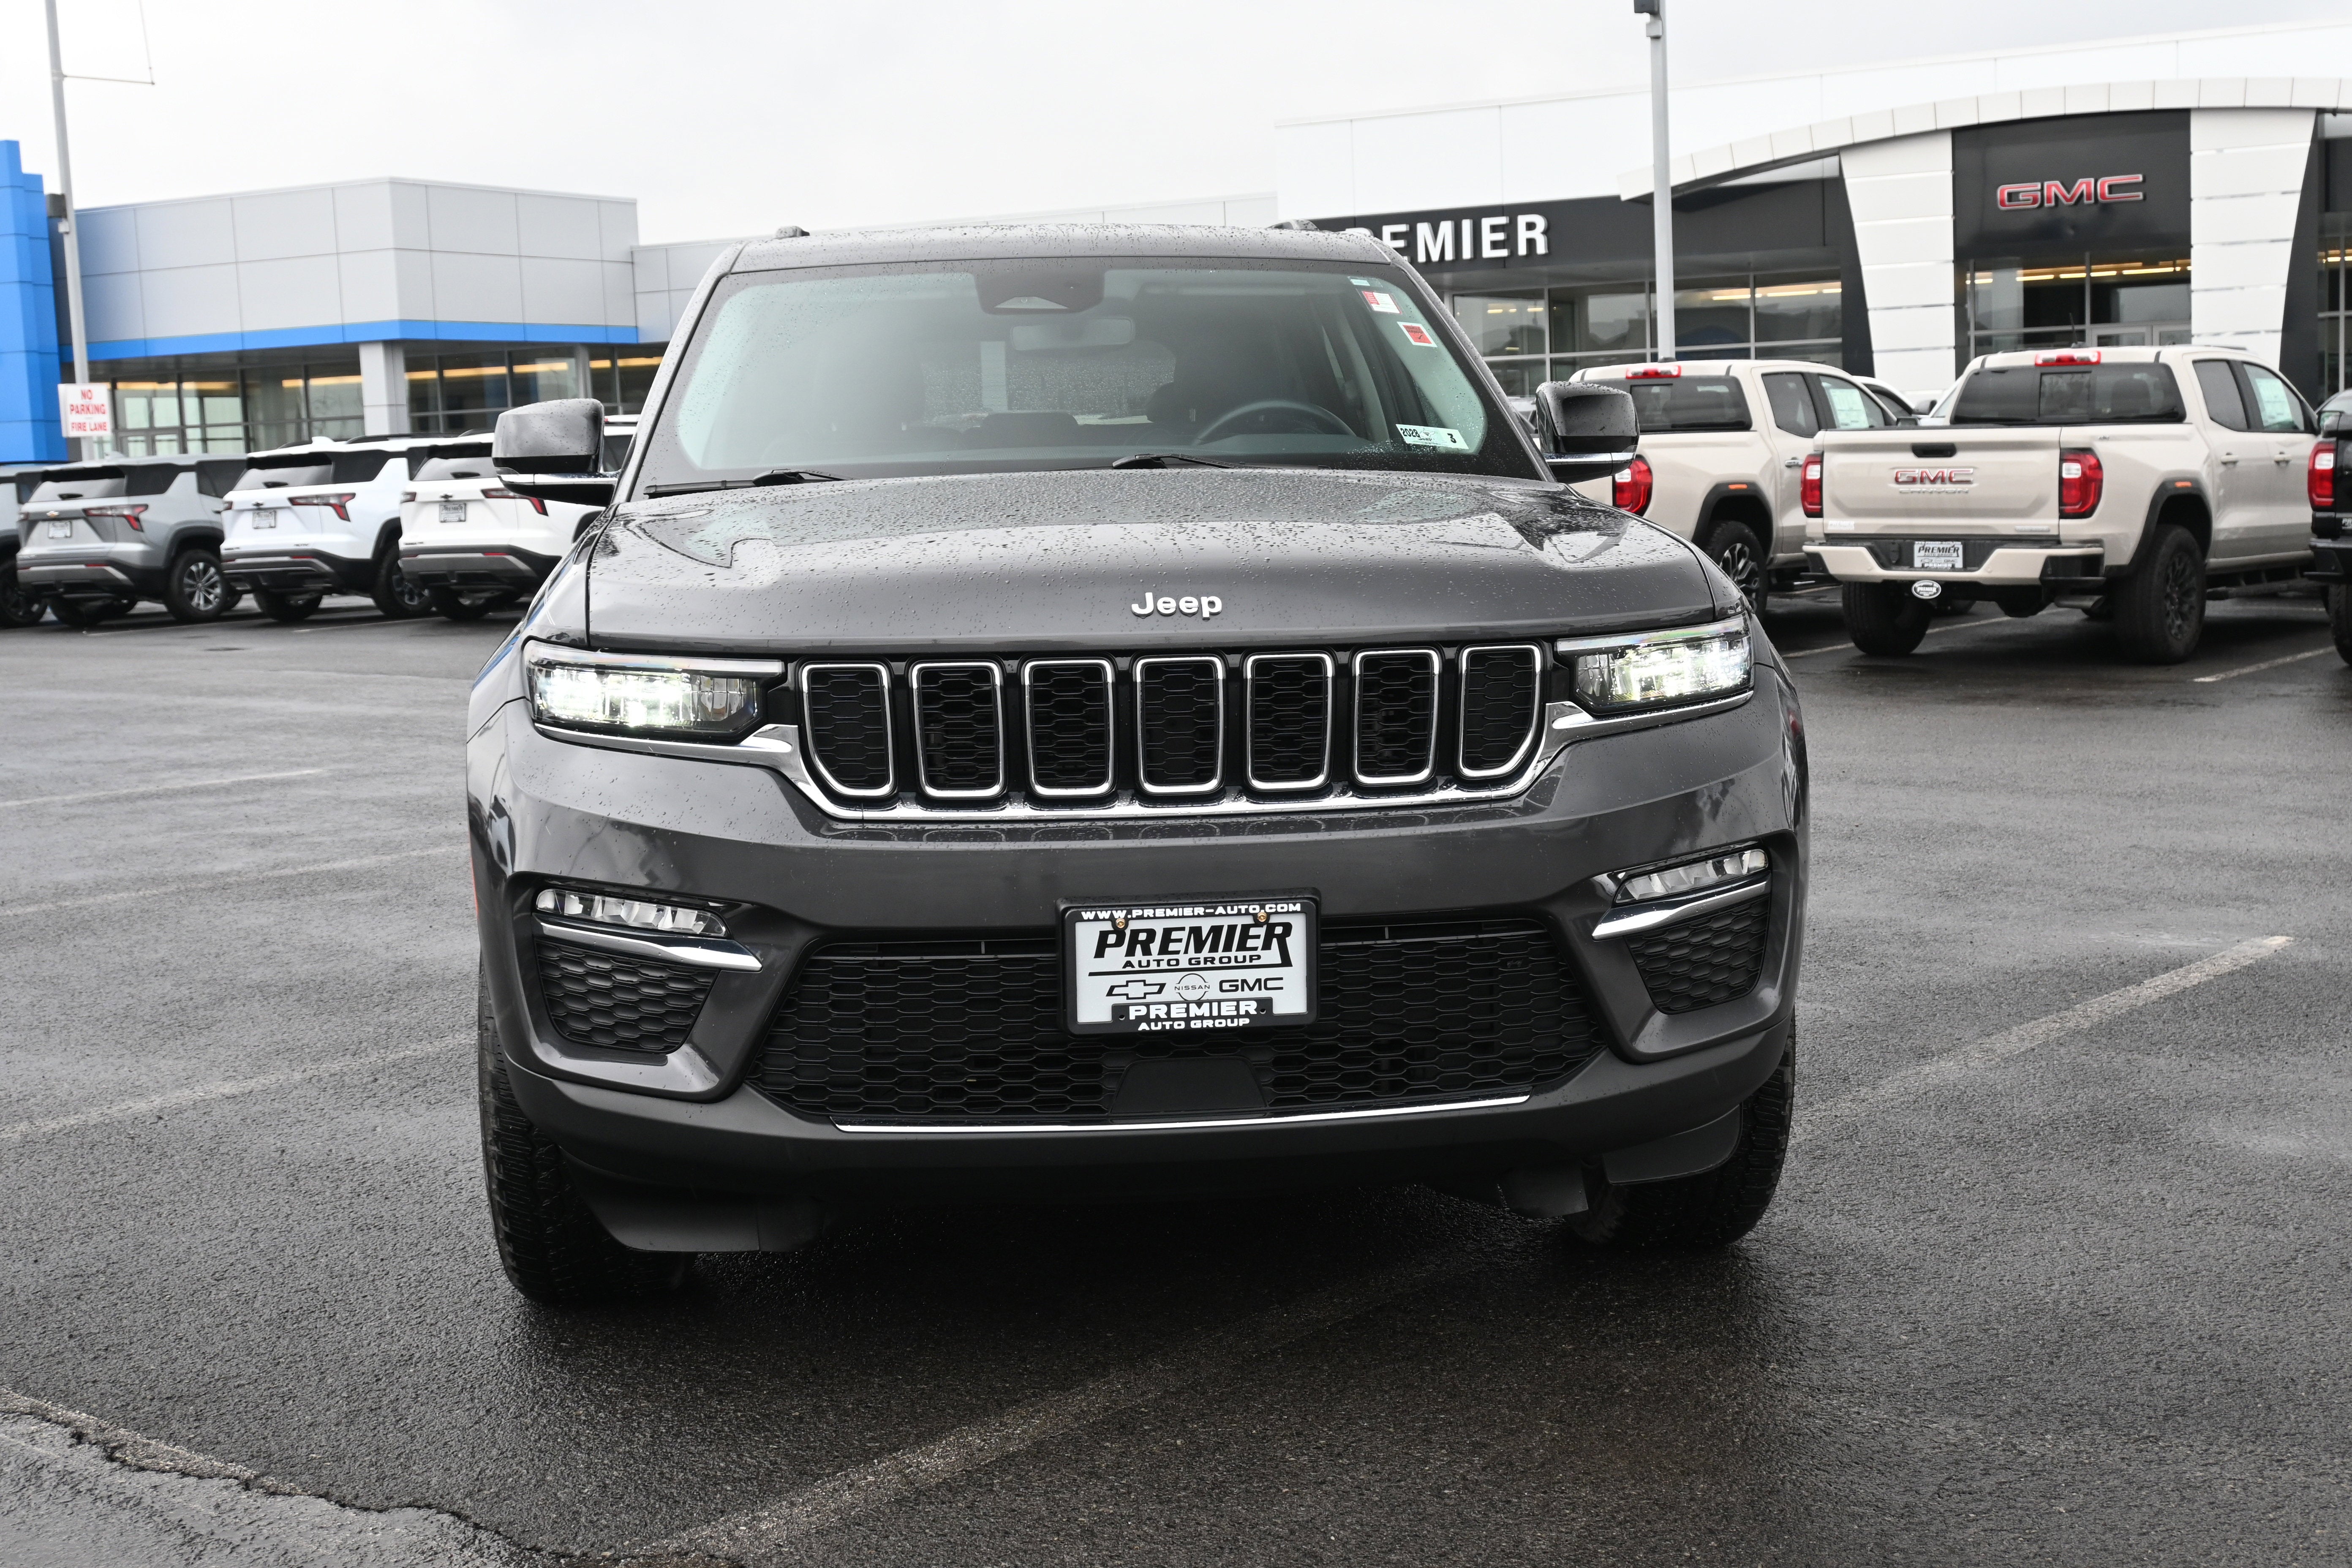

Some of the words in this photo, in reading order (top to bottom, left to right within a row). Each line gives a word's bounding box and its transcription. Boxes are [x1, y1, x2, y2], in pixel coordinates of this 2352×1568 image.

[1997, 174, 2143, 210] GMC
[1346, 214, 1548, 263] EMIER
[81, 389, 93, 400] NO
[70, 404, 106, 414] PARKING
[71, 422, 87, 431] FIRE
[89, 422, 107, 431] LANE
[1400, 428, 1420, 438] 2028
[1447, 433, 1456, 443] 3
[1895, 468, 1974, 485] GMC
[1918, 546, 1960, 557] PREMIER
[1131, 592, 1222, 620] Jeep
[1081, 903, 1301, 920] WWW.PREMIER-AUTO.COM
[1093, 922, 1293, 967] PREMIER
[1122, 958, 1179, 969] AUTO
[1188, 954, 1261, 966] GROUP
[1219, 977, 1284, 993] GMC
[1129, 1000, 1258, 1020] PREMIER
[1138, 1021, 1185, 1031] AUTO
[1190, 1018, 1250, 1028] GROUP
